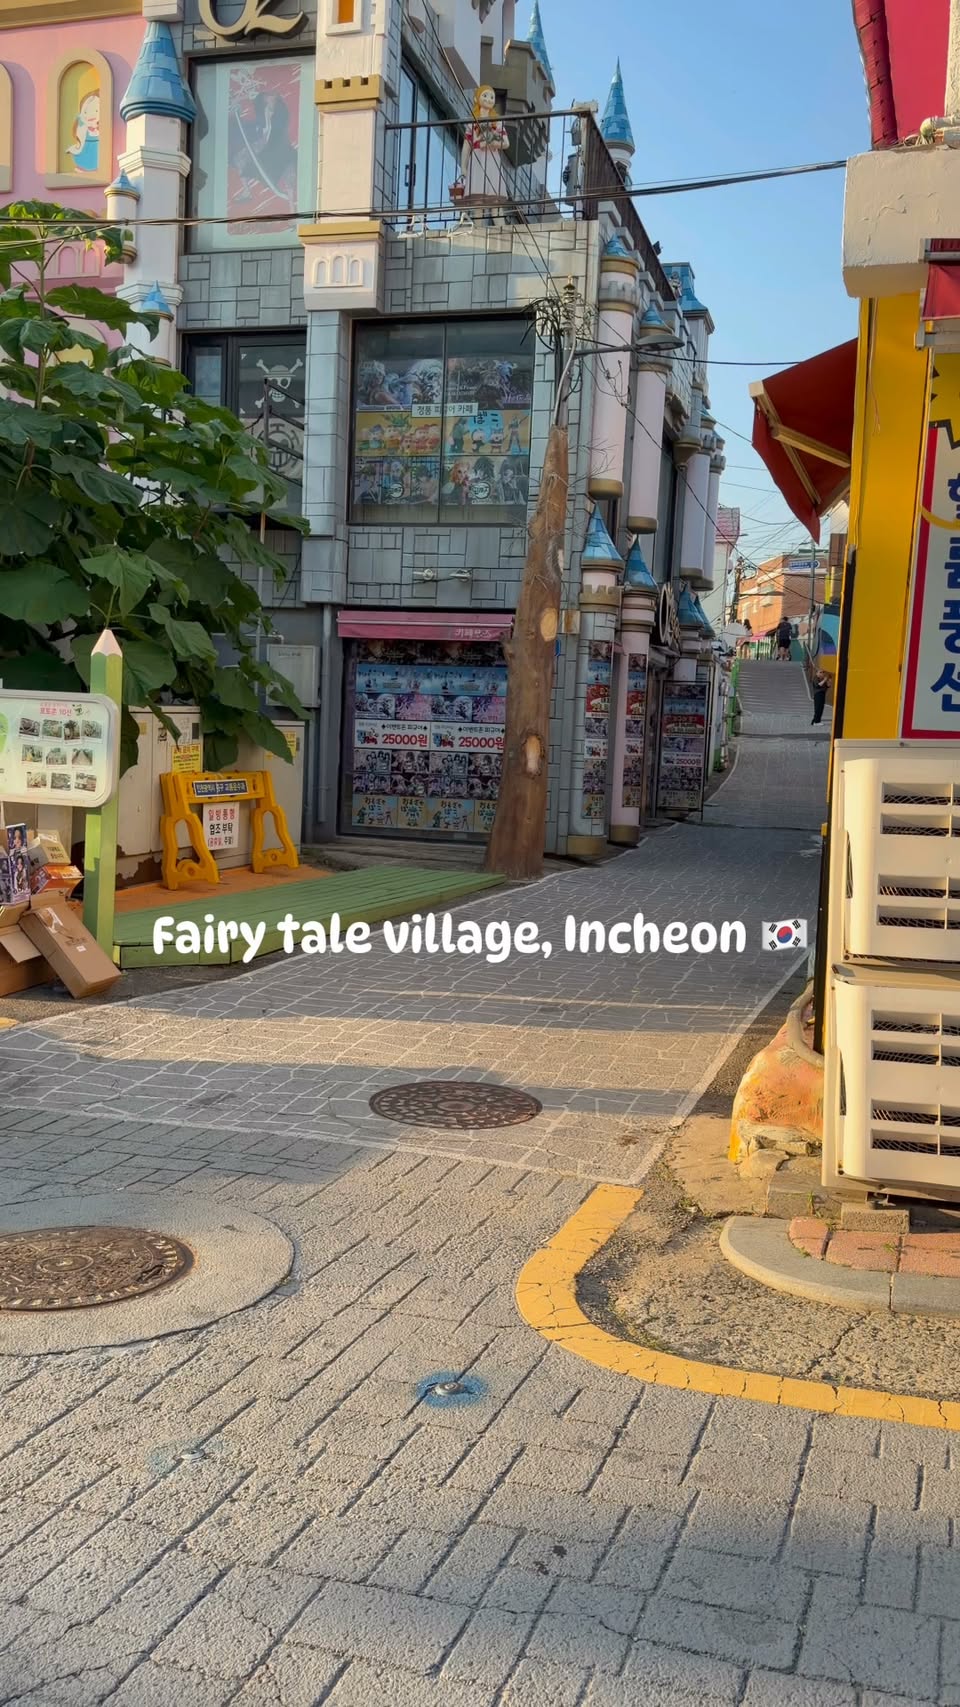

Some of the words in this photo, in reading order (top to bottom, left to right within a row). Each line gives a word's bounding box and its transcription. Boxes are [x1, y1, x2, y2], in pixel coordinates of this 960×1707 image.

[416, 405, 431, 416] 정품
[434, 405, 456, 415] 피어
[458, 404, 474, 414] 카페
[382, 733, 428, 747] 25000원
[458, 736, 505, 750] 25000원
[208, 808, 234, 820] 일방통행
[209, 823, 221, 835] 협조
[222, 822, 233, 834] 부탁
